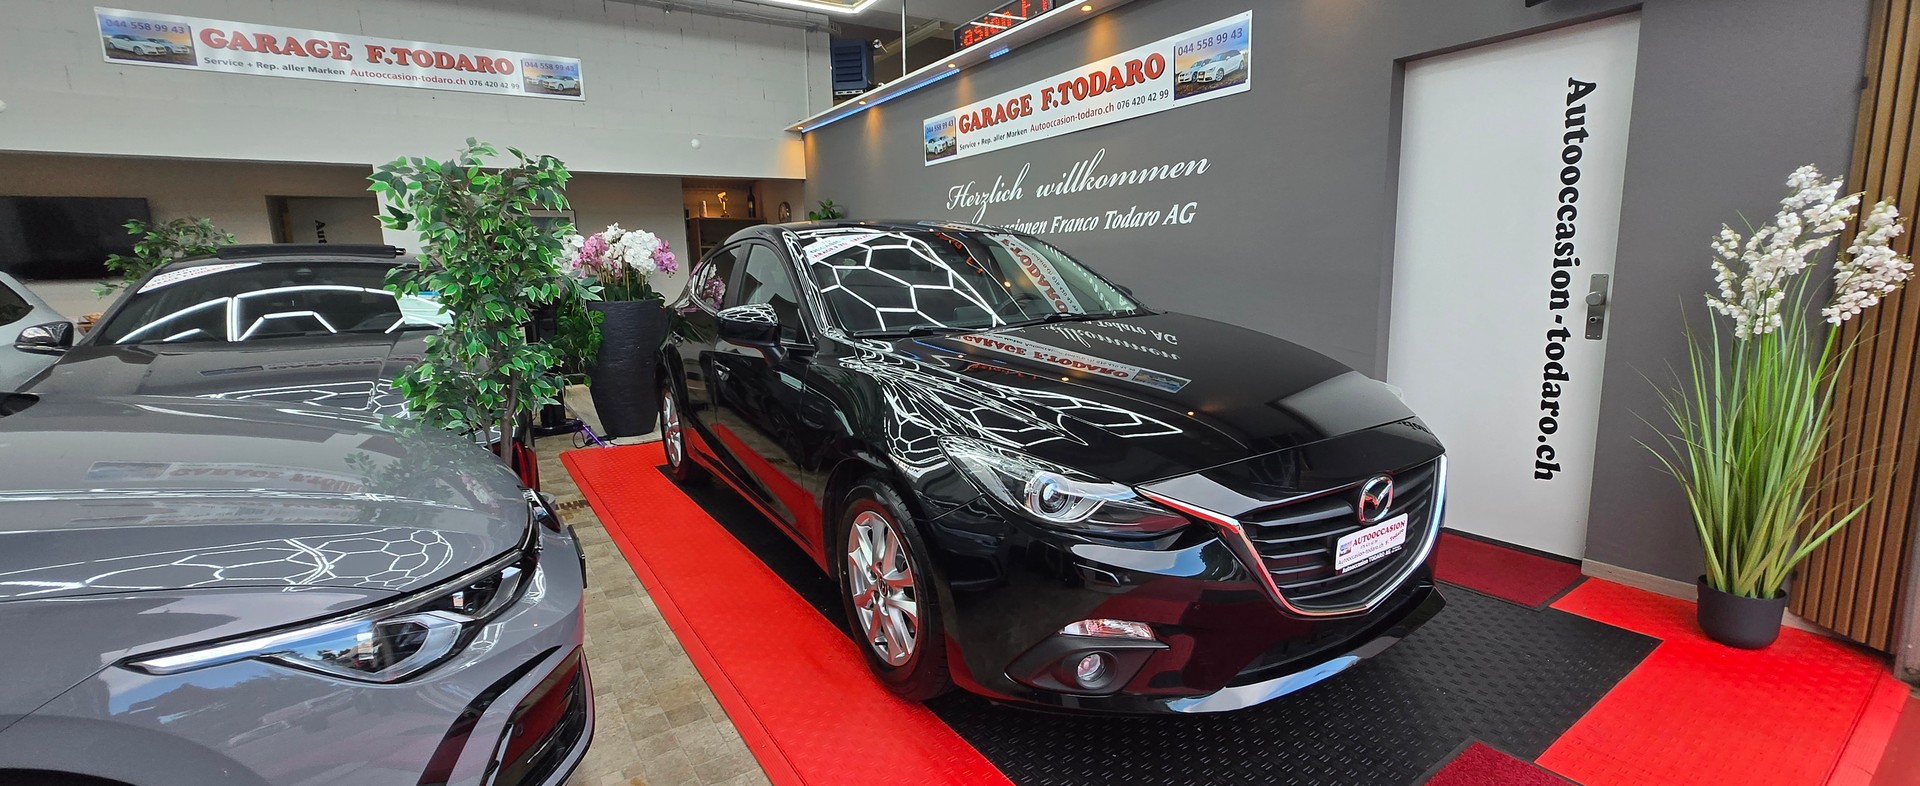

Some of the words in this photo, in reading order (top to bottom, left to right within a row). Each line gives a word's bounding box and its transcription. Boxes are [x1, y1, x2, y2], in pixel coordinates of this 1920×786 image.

[106, 19, 127, 30] 044
[130, 21, 151, 32] 558
[155, 23, 169, 34] 99
[170, 25, 185, 35] 43
[1178, 44, 1194, 57] 044
[1197, 36, 1214, 51] 558
[1216, 32, 1228, 45] 99
[1230, 27, 1243, 40] 43
[199, 28, 352, 62] GARAGE
[364, 44, 515, 76] F.TODARO
[524, 61, 540, 70] 044
[540, 62, 554, 71] 558
[554, 63, 565, 72] 99
[565, 64, 575, 73] 43
[203, 57, 244, 68] Service
[256, 61, 280, 73] Rep.
[282, 64, 306, 74] aller
[308, 66, 346, 77] Marken
[350, 69, 466, 86] Autooccasion-todaro.ch
[468, 80, 483, 88] 076
[484, 80, 499, 89] 420
[500, 82, 512, 90] 42
[511, 82, 521, 90] 99
[958, 93, 1033, 134] GARAGE
[1040, 53, 1165, 112] F.TODARO
[941, 121, 948, 132] 99
[948, 119, 954, 129] 43
[959, 142, 976, 151] Service
[981, 135, 993, 146] Rep.
[993, 132, 1005, 143] aller
[1006, 127, 1028, 140] Marken
[1030, 102, 1115, 134] Autooccasion-todaro.ch
[1116, 98, 1130, 111] 076
[1131, 95, 1146, 107] 420
[1147, 92, 1157, 103] 42
[1159, 88, 1169, 100] 99
[946, 162, 1031, 225] Herzlich
[1036, 147, 1211, 198] willkommen
[1050, 213, 1099, 235] Franco
[1103, 208, 1161, 230] Todaro
[1162, 201, 1198, 225] AG
[1535, 77, 1597, 481] Autooccasion-todaro.ch
[1352, 520, 1406, 547] AUTOOCCASION
[1390, 528, 1405, 542] Todaro
